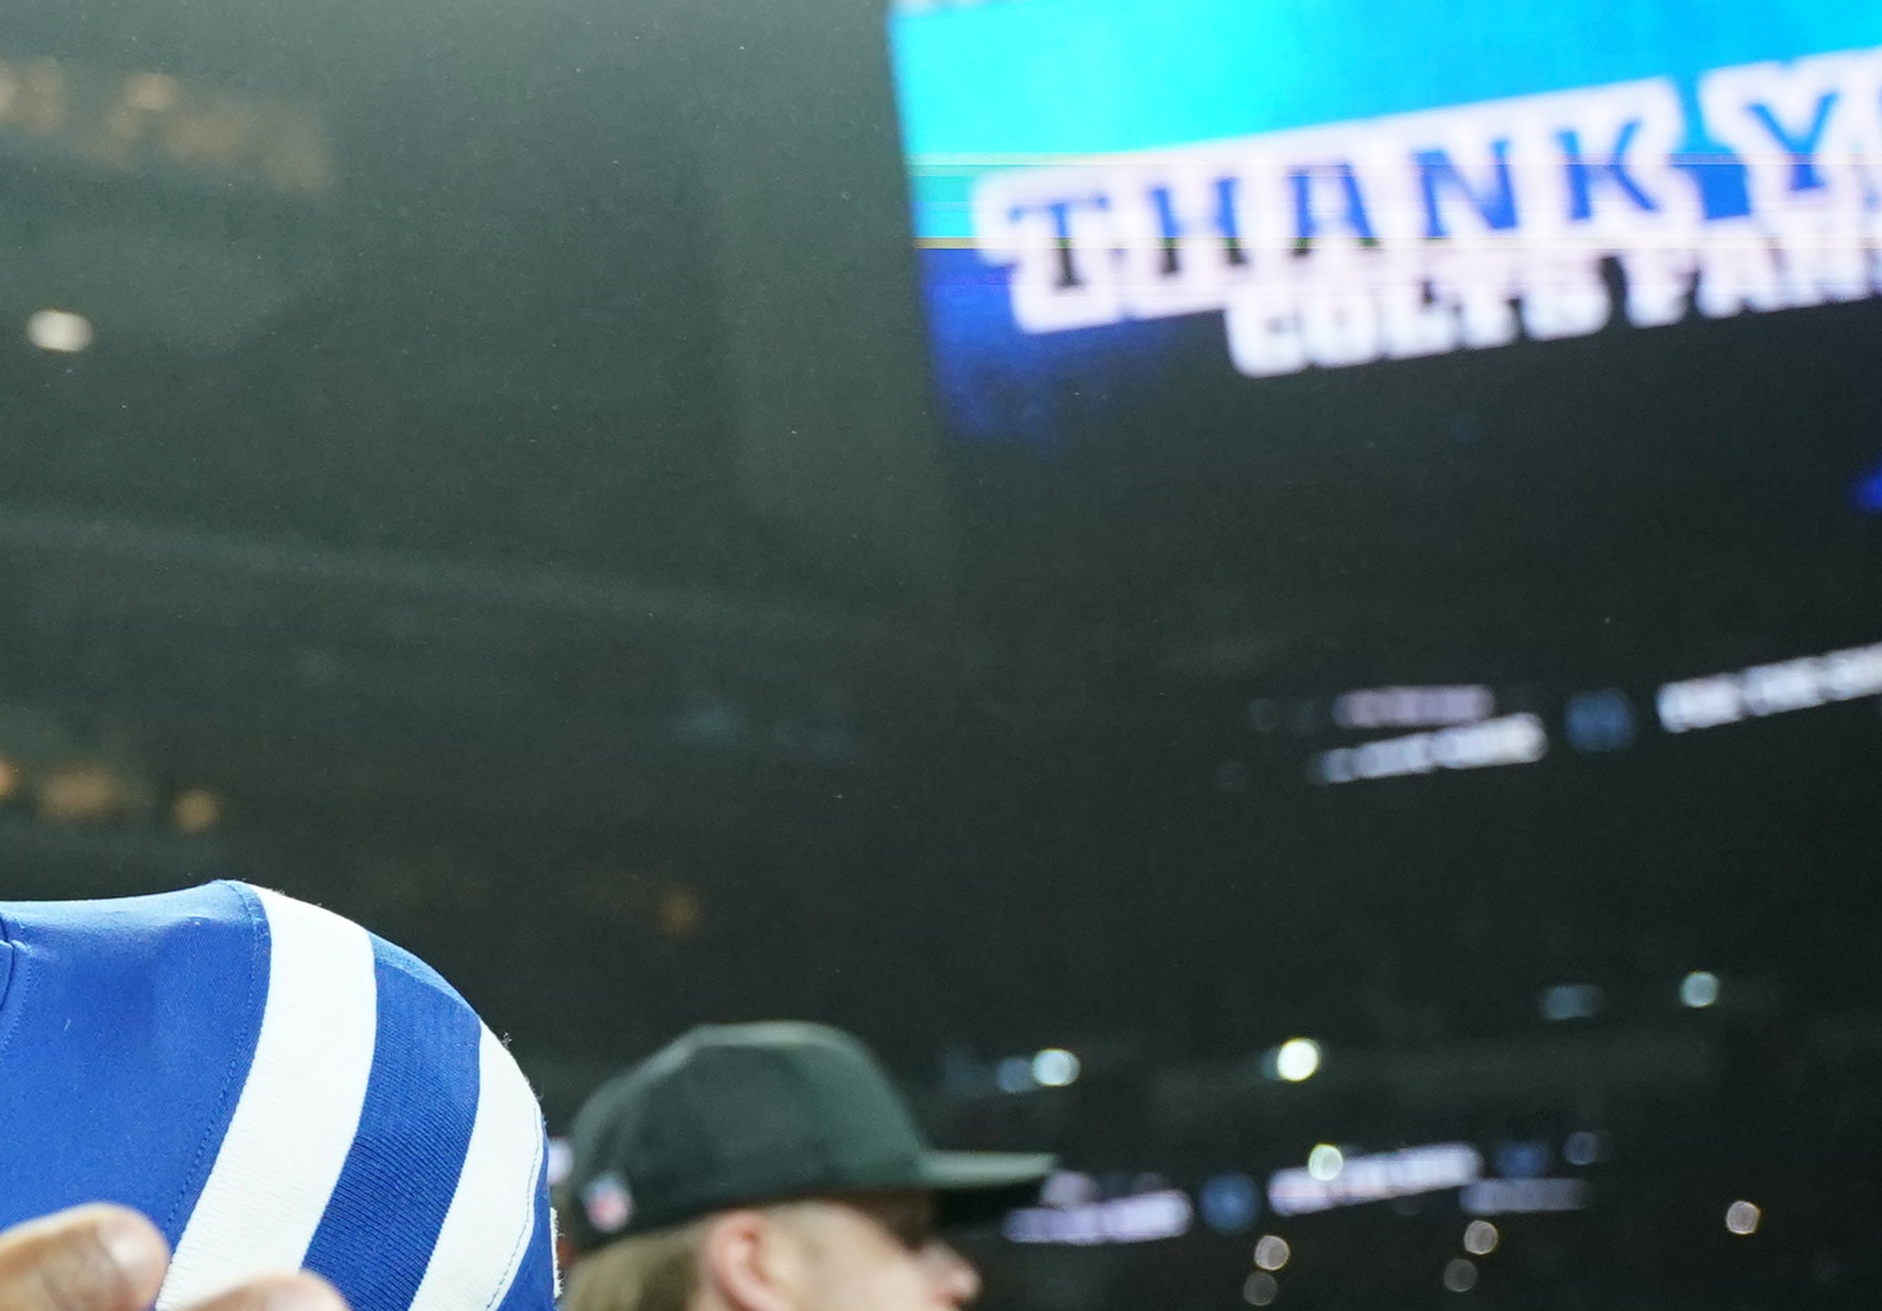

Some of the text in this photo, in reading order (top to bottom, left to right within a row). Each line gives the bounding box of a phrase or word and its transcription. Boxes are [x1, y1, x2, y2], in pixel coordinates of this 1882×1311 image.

[983, 62, 1882, 320] THANK Y
[1223, 222, 1882, 379] COLTS FAN
